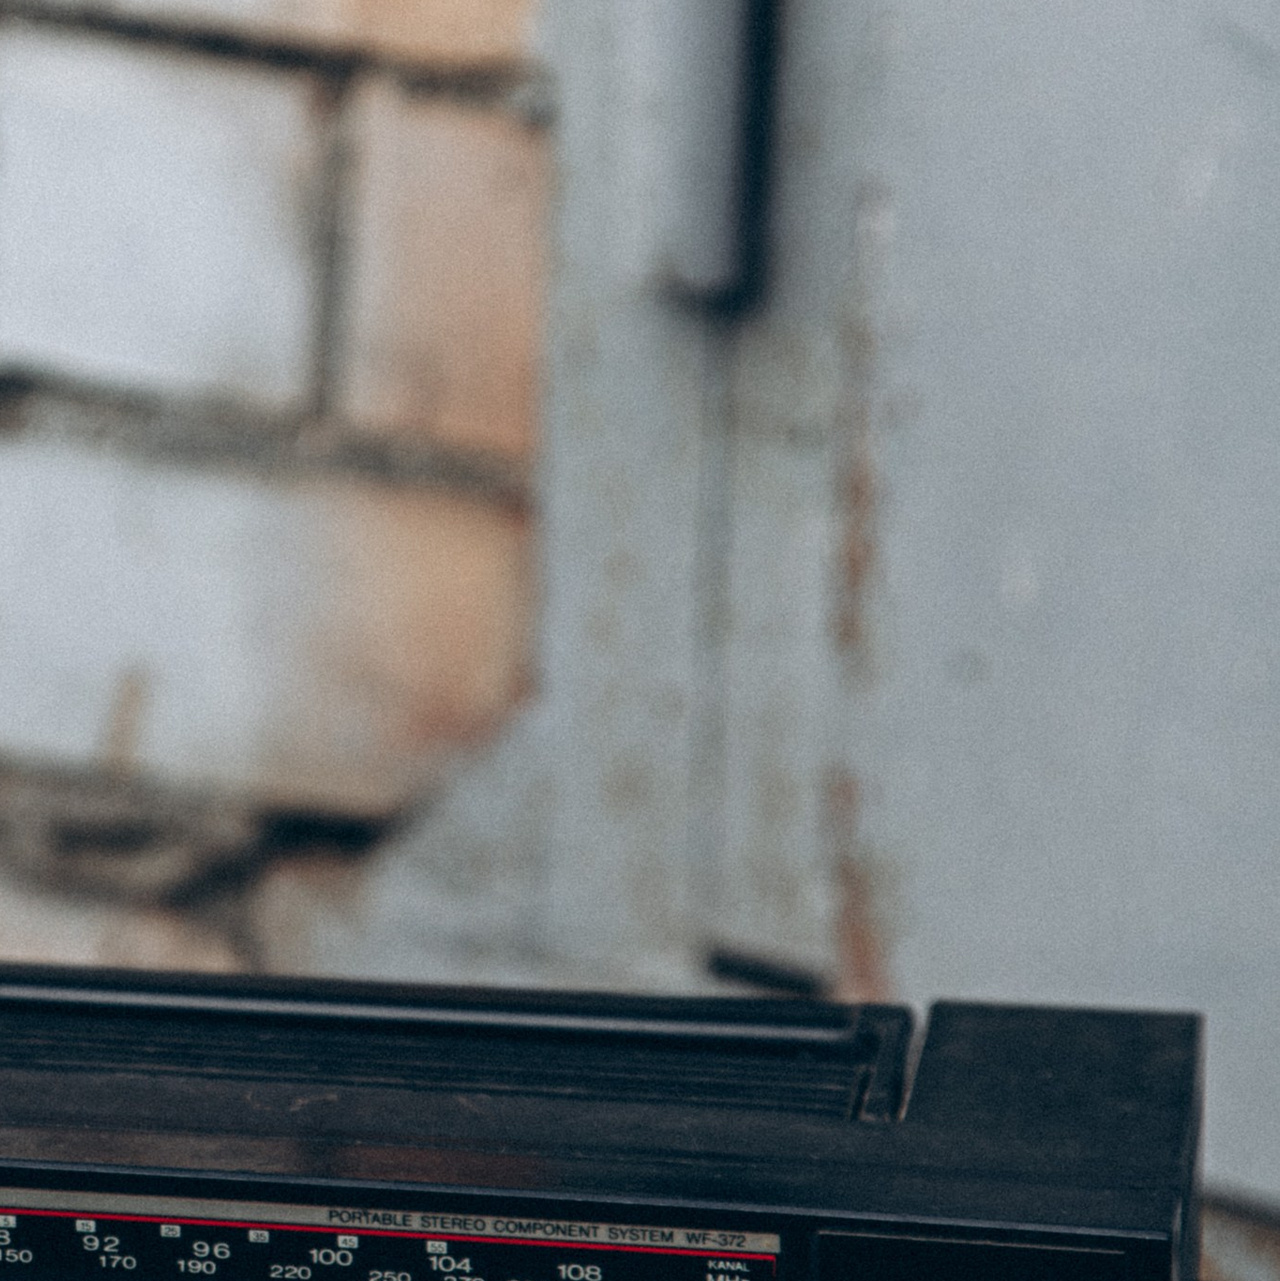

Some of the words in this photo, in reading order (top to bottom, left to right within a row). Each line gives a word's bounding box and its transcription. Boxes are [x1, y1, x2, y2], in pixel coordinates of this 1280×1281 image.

[329, 1210, 413, 1226] PORTABLE
[420, 1215, 487, 1232] STEREO
[493, 1220, 599, 1238] COMPONENT
[608, 1226, 674, 1243] SYSTEM
[685, 1232, 747, 1248] WF-372
[82, 1235, 120, 1252] 92
[193, 1241, 231, 1259] 96
[309, 1248, 353, 1266] 100
[428, 1255, 471, 1272] 104
[557, 1264, 602, 1281] 108
[99, 1254, 137, 1270] 170
[176, 1259, 216, 1275] 190
[270, 1265, 312, 1280] 220
[708, 1260, 750, 1272] KANAL
